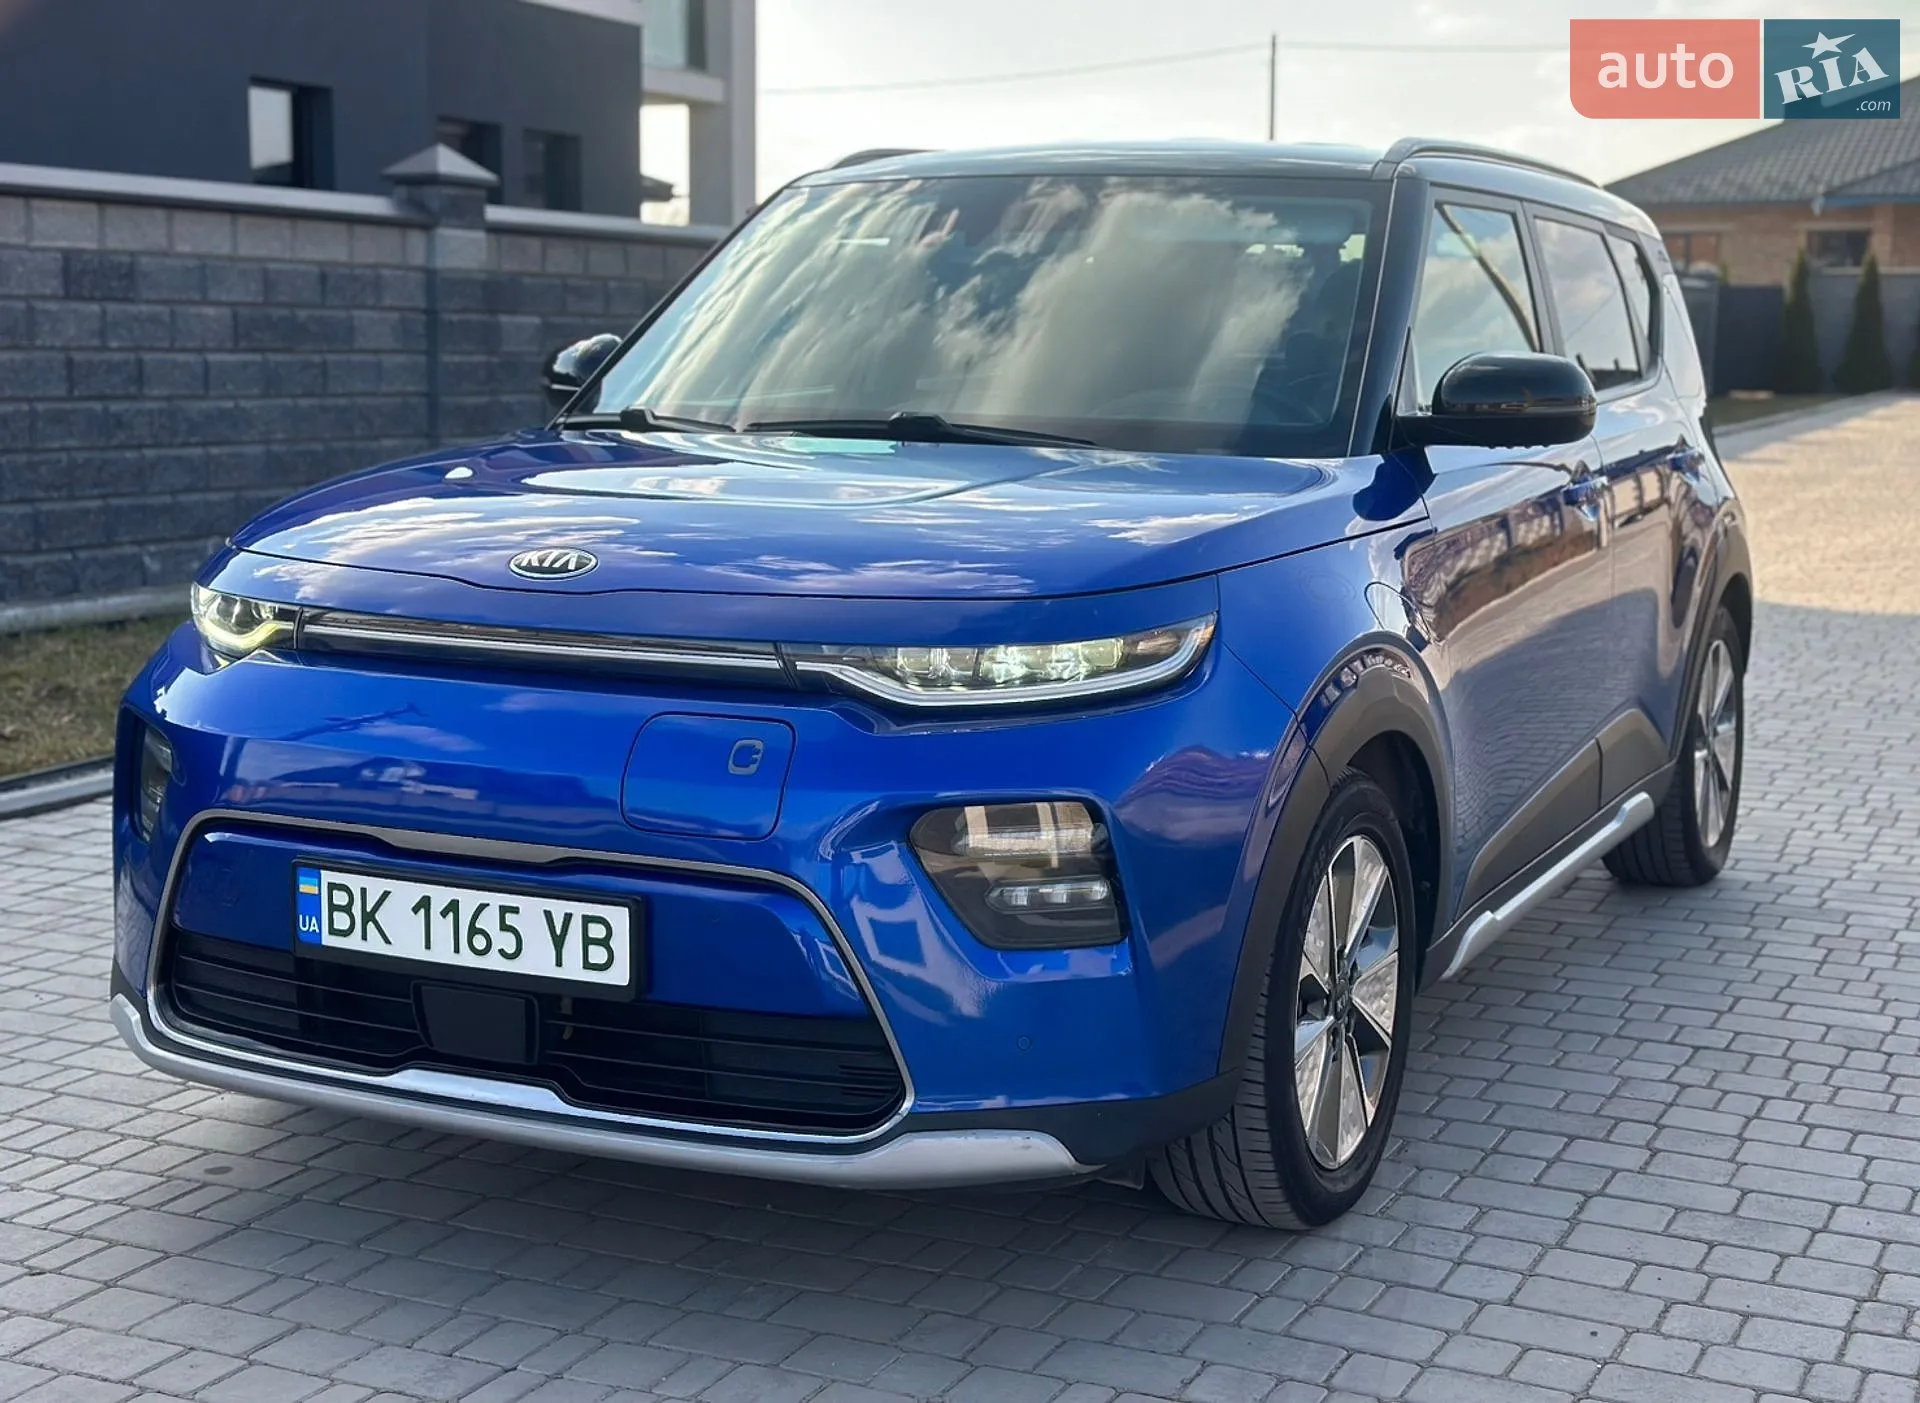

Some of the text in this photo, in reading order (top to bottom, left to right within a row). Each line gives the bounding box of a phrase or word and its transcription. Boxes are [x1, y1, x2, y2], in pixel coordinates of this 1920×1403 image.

[520, 550, 578, 570] KIA
[299, 914, 320, 933] UA
[327, 881, 615, 972] BK 1165 YB
